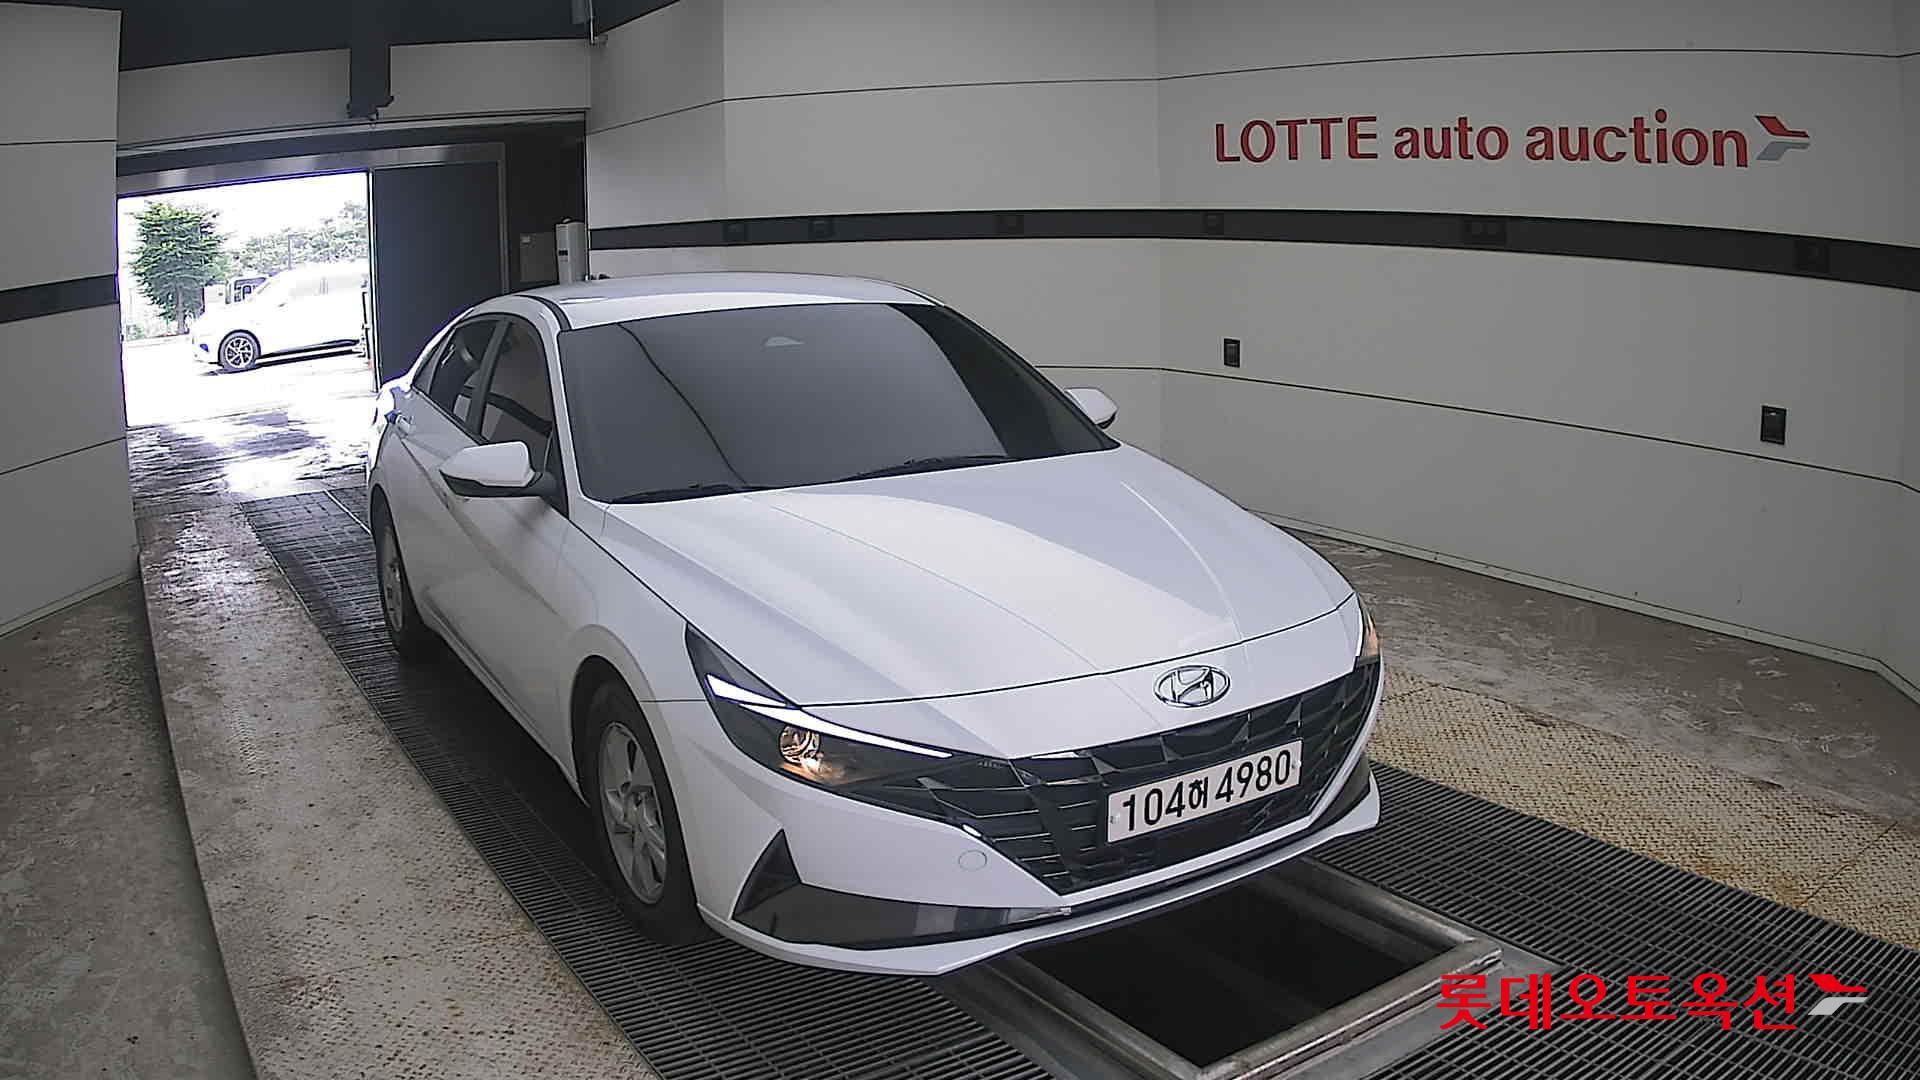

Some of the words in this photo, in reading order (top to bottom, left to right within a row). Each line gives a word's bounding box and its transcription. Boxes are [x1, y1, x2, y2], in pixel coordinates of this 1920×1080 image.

[1215, 115, 1378, 164] LOTTE
[1394, 116, 1509, 161] auto
[1525, 109, 1748, 168] auction
[1122, 776, 1209, 831] 104허
[1215, 750, 1291, 803] 4980
